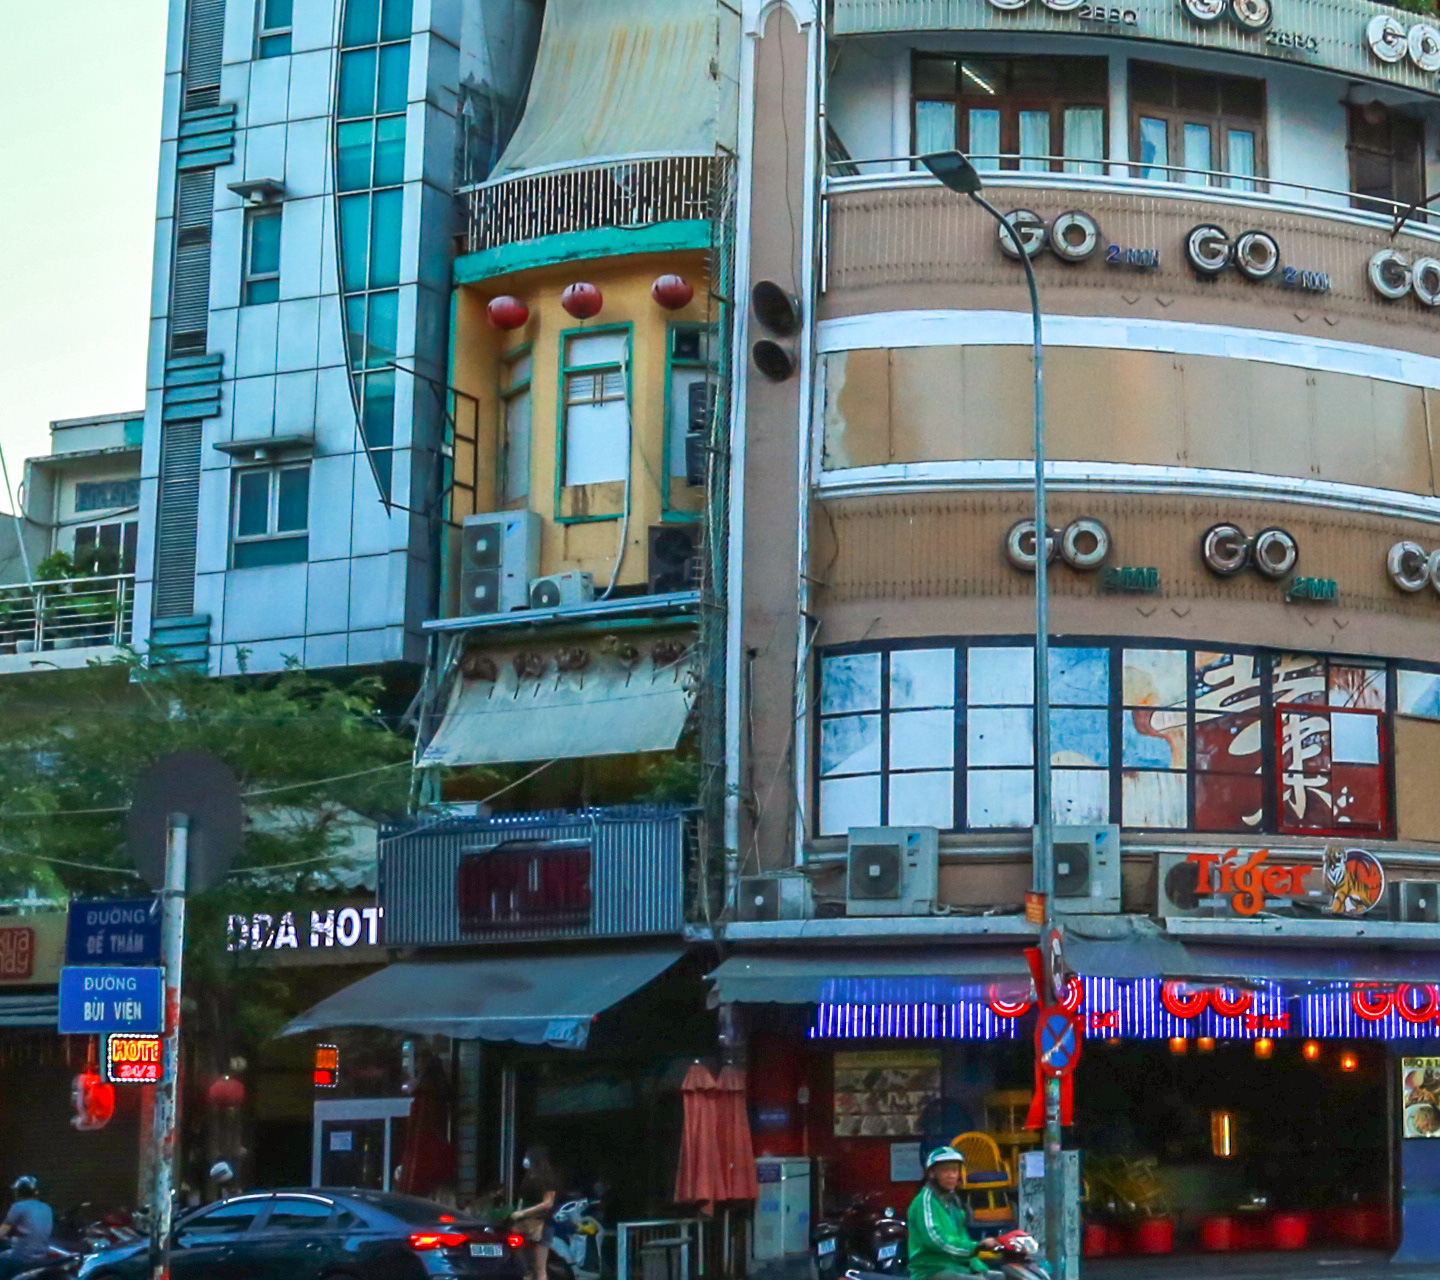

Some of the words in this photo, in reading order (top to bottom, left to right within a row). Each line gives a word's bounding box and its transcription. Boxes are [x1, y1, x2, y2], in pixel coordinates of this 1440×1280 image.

[997, 208, 1101, 262] GO
[1184, 224, 1280, 280] GO
[1202, 522, 1298, 577] GO
[1187, 848, 1313, 916] Tiger
[84, 975, 137, 991] ĐƯỜNG
[84, 997, 104, 1021] BÙI
[114, 998, 142, 1025] VIỆN
